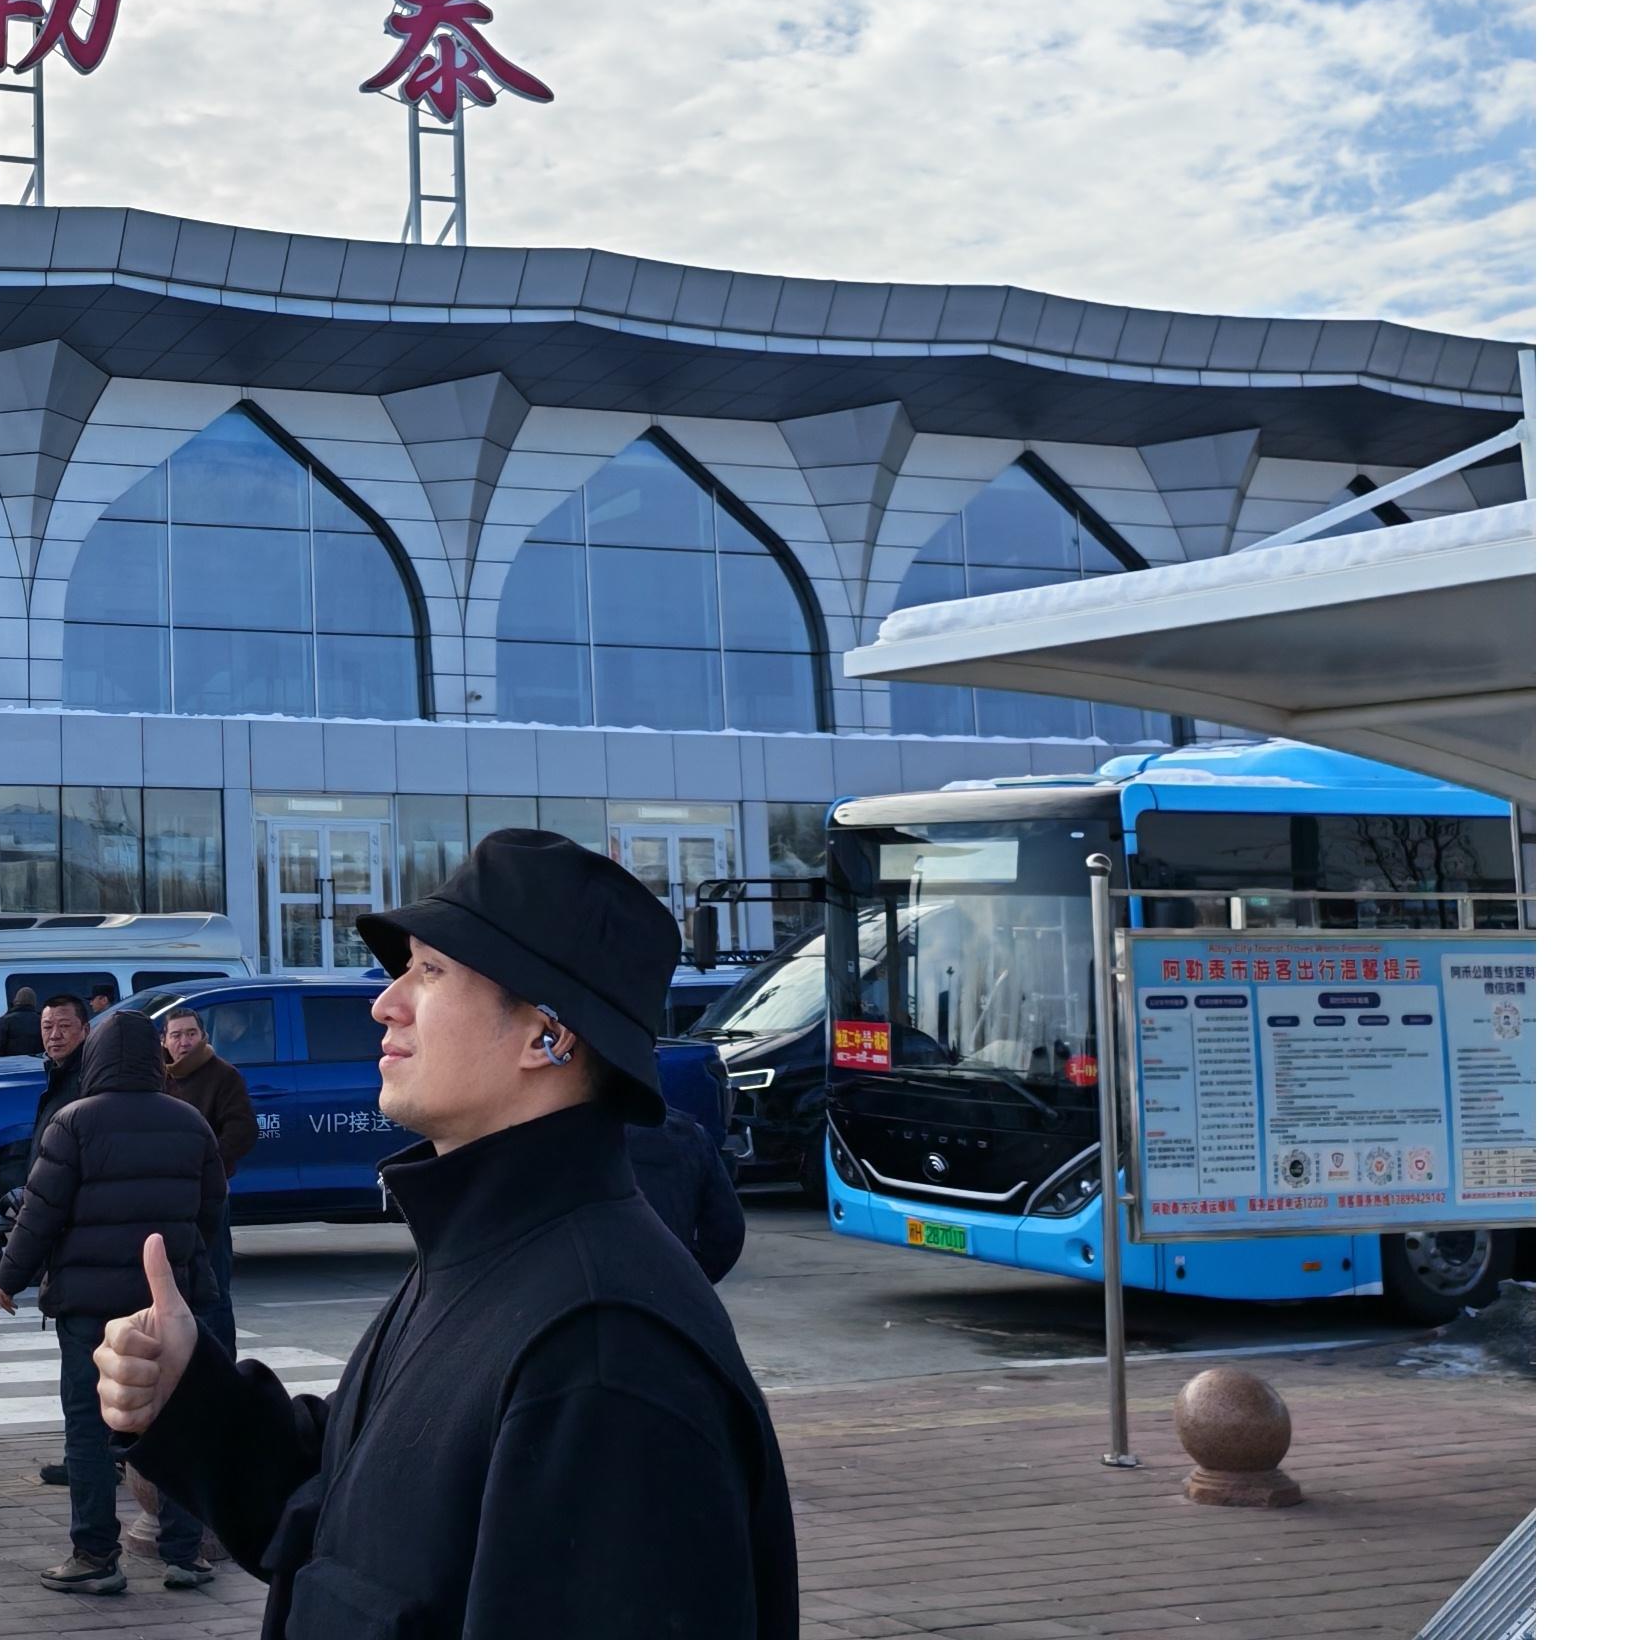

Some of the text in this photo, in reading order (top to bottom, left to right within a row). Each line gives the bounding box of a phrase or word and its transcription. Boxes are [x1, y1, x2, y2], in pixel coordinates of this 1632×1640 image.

[1162, 958, 1422, 982] 阿勒泰市游客出行温馨提示
